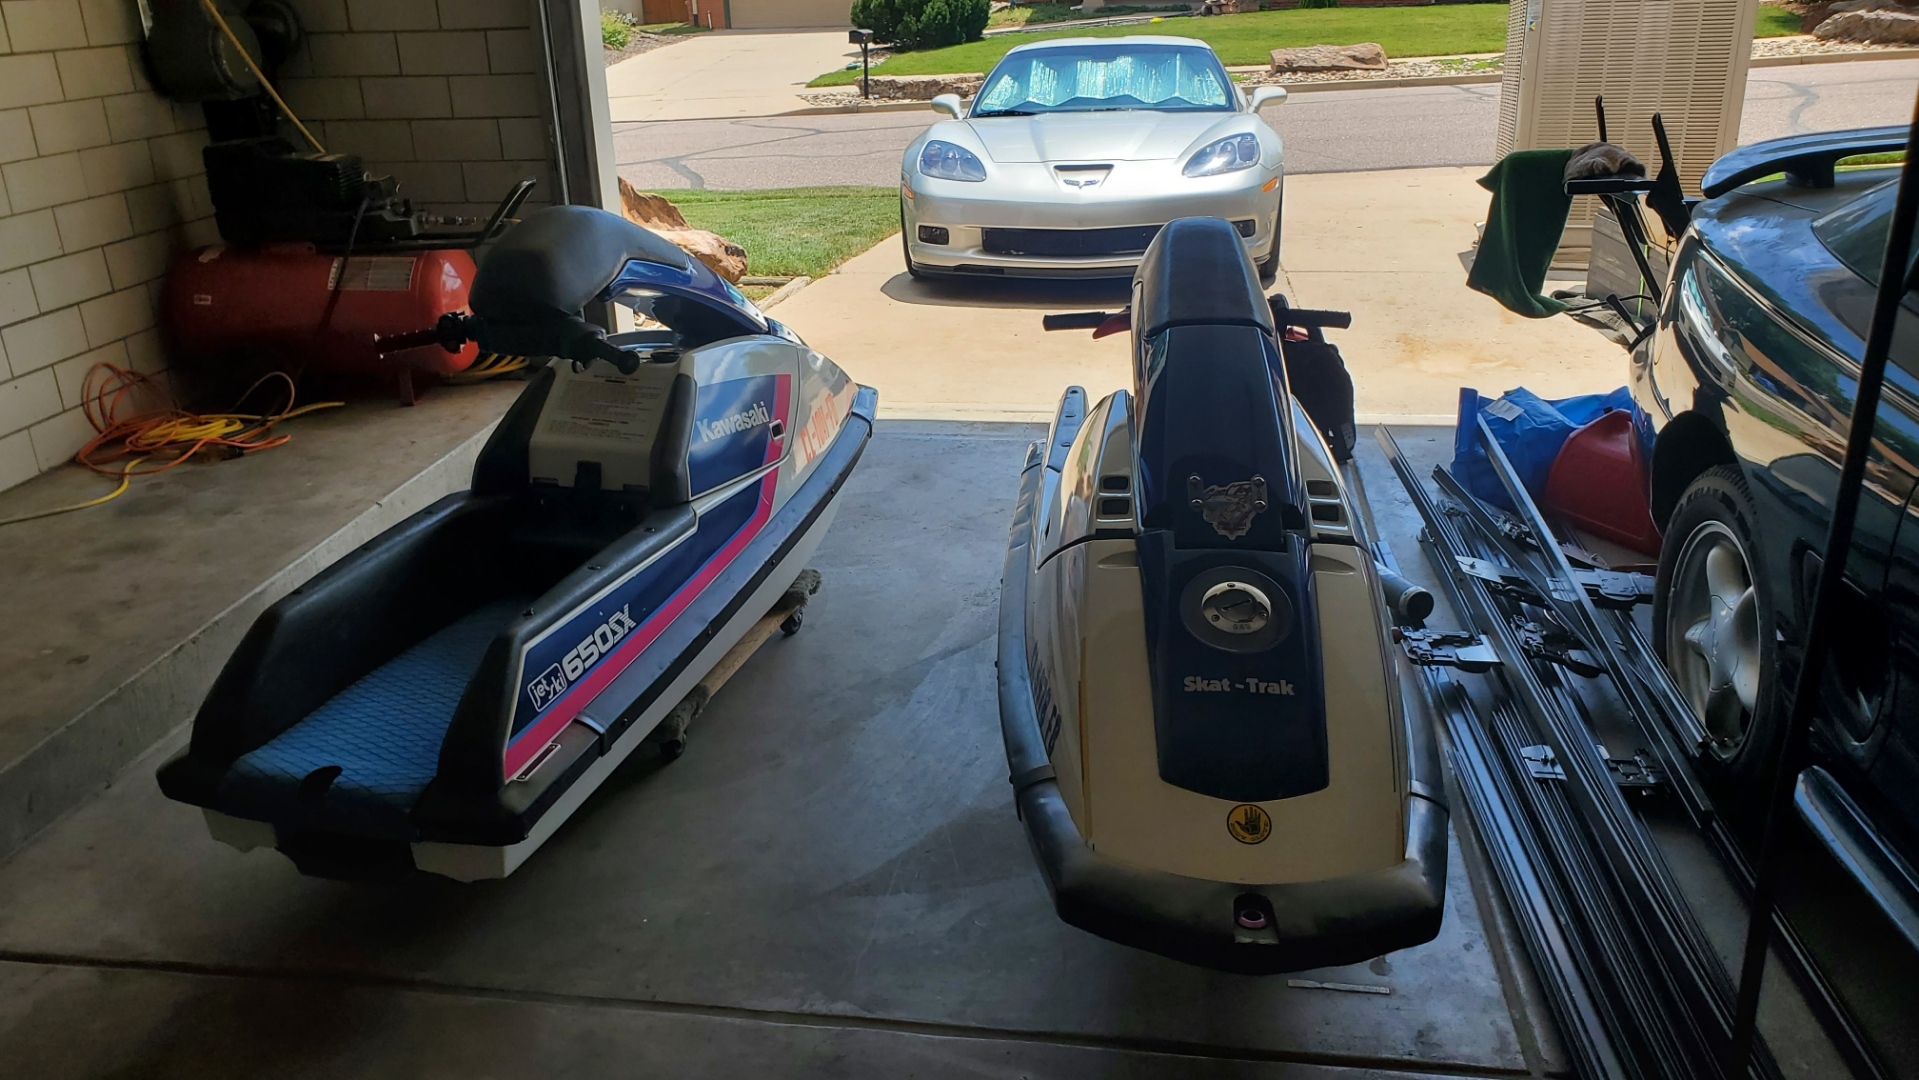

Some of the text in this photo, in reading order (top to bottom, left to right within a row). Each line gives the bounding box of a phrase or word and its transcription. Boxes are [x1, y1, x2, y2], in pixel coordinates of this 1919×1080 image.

[696, 401, 770, 442] Kawasaki
[531, 603, 637, 707] jet ski 650SX
[1183, 676, 1231, 693] Skat
